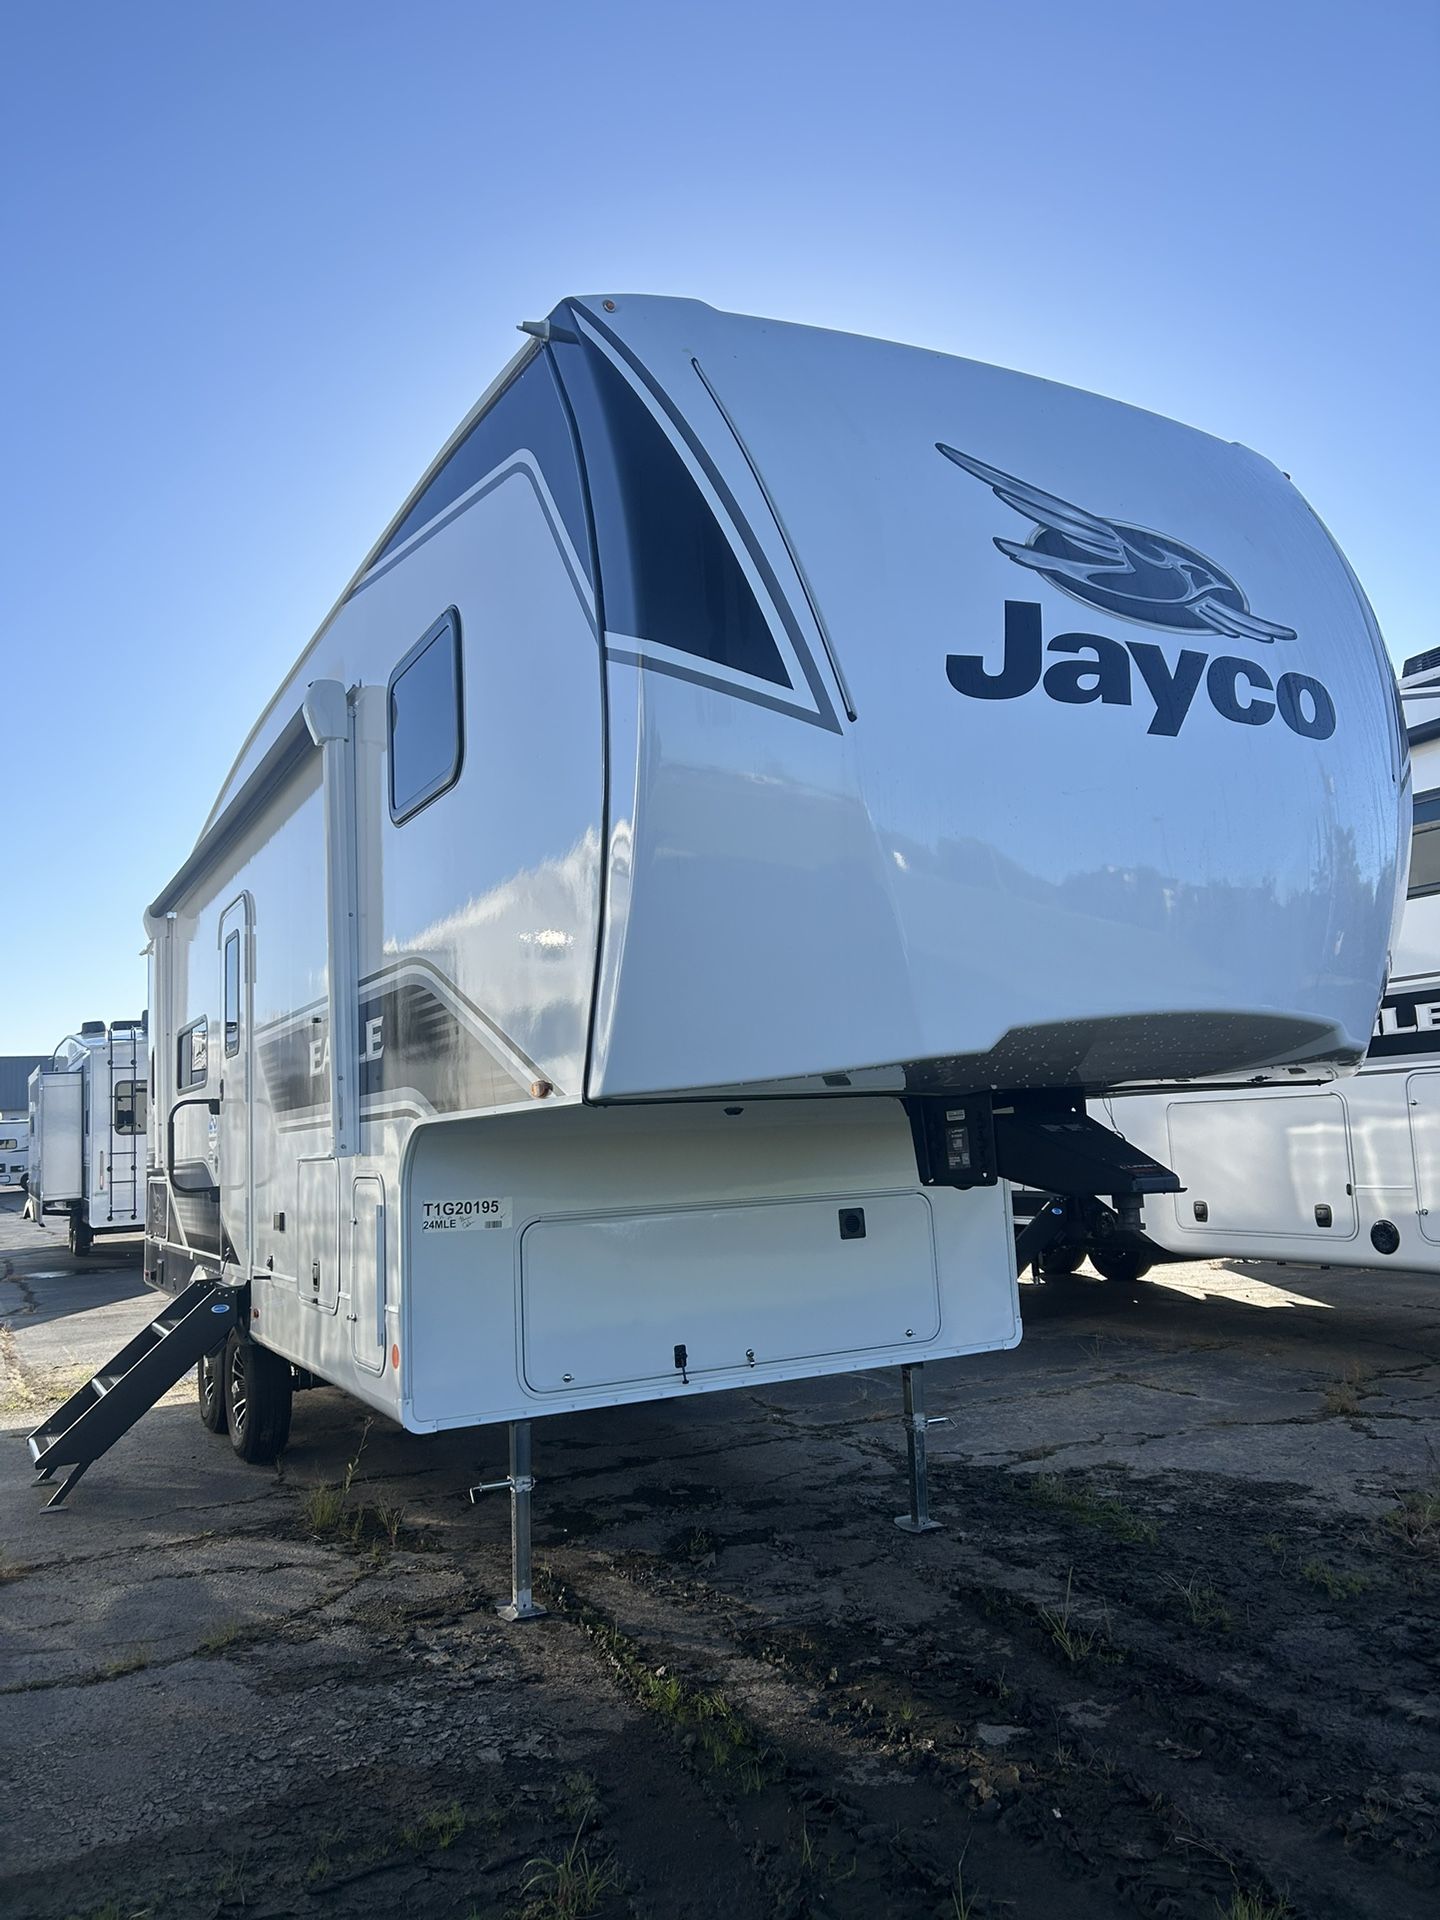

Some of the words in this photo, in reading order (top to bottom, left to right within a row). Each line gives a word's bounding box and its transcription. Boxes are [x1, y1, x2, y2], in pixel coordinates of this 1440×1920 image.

[945, 599, 1337, 741] Jayco
[1371, 1001, 1440, 1036] LE
[423, 1200, 499, 1216] T1G20195
[423, 1219, 457, 1230] 24MLE
